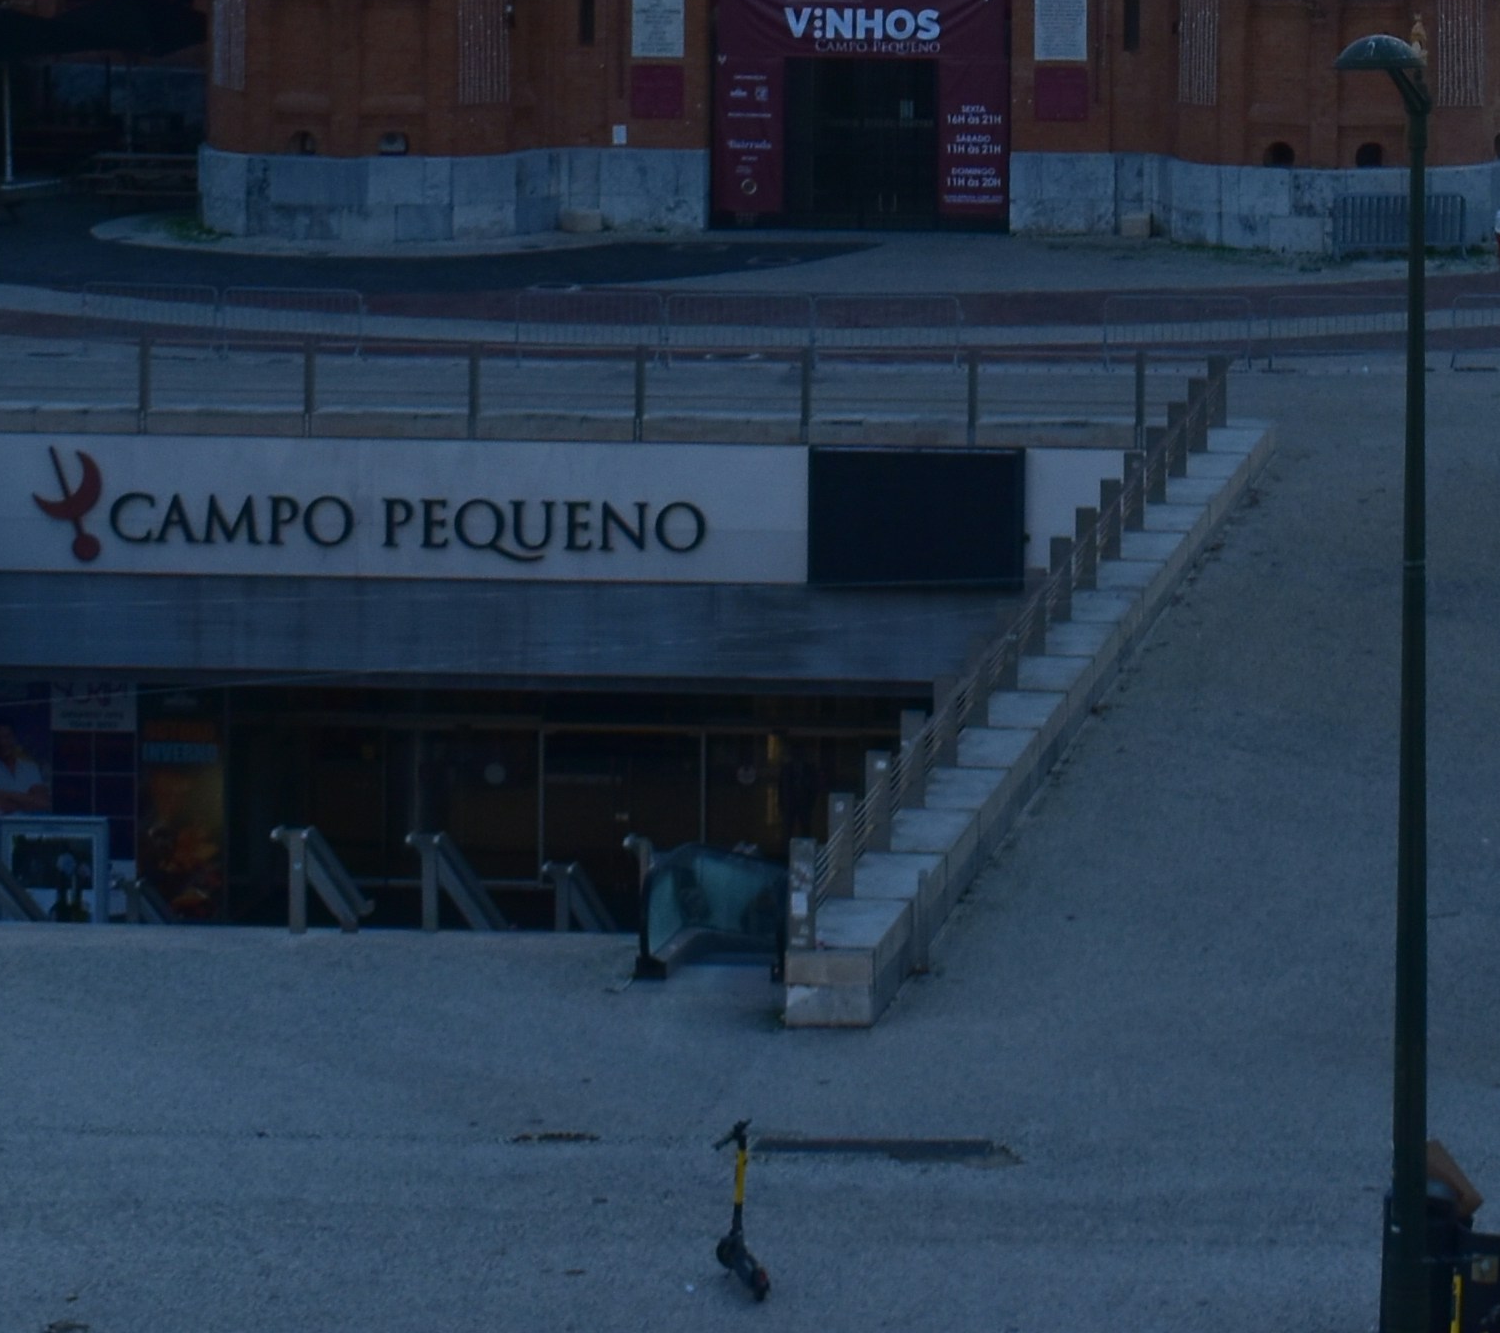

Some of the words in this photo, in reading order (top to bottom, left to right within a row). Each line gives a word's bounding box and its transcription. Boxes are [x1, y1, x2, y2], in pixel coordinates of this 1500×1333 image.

[815, 39, 868, 52] CAMPO
[873, 40, 941, 55] PEQUENO
[961, 104, 986, 114] SEXTA
[947, 114, 965, 125] 16H
[982, 114, 1002, 125] 21H
[956, 134, 992, 143] SÁBADO
[947, 144, 965, 154] 11H
[982, 144, 1002, 154] 21H
[951, 166, 996, 176] DOMINGO
[946, 176, 965, 187] 11H
[982, 176, 1001, 187] 20H
[110, 492, 355, 546] CAMPO
[383, 497, 705, 562] PEQUENO
